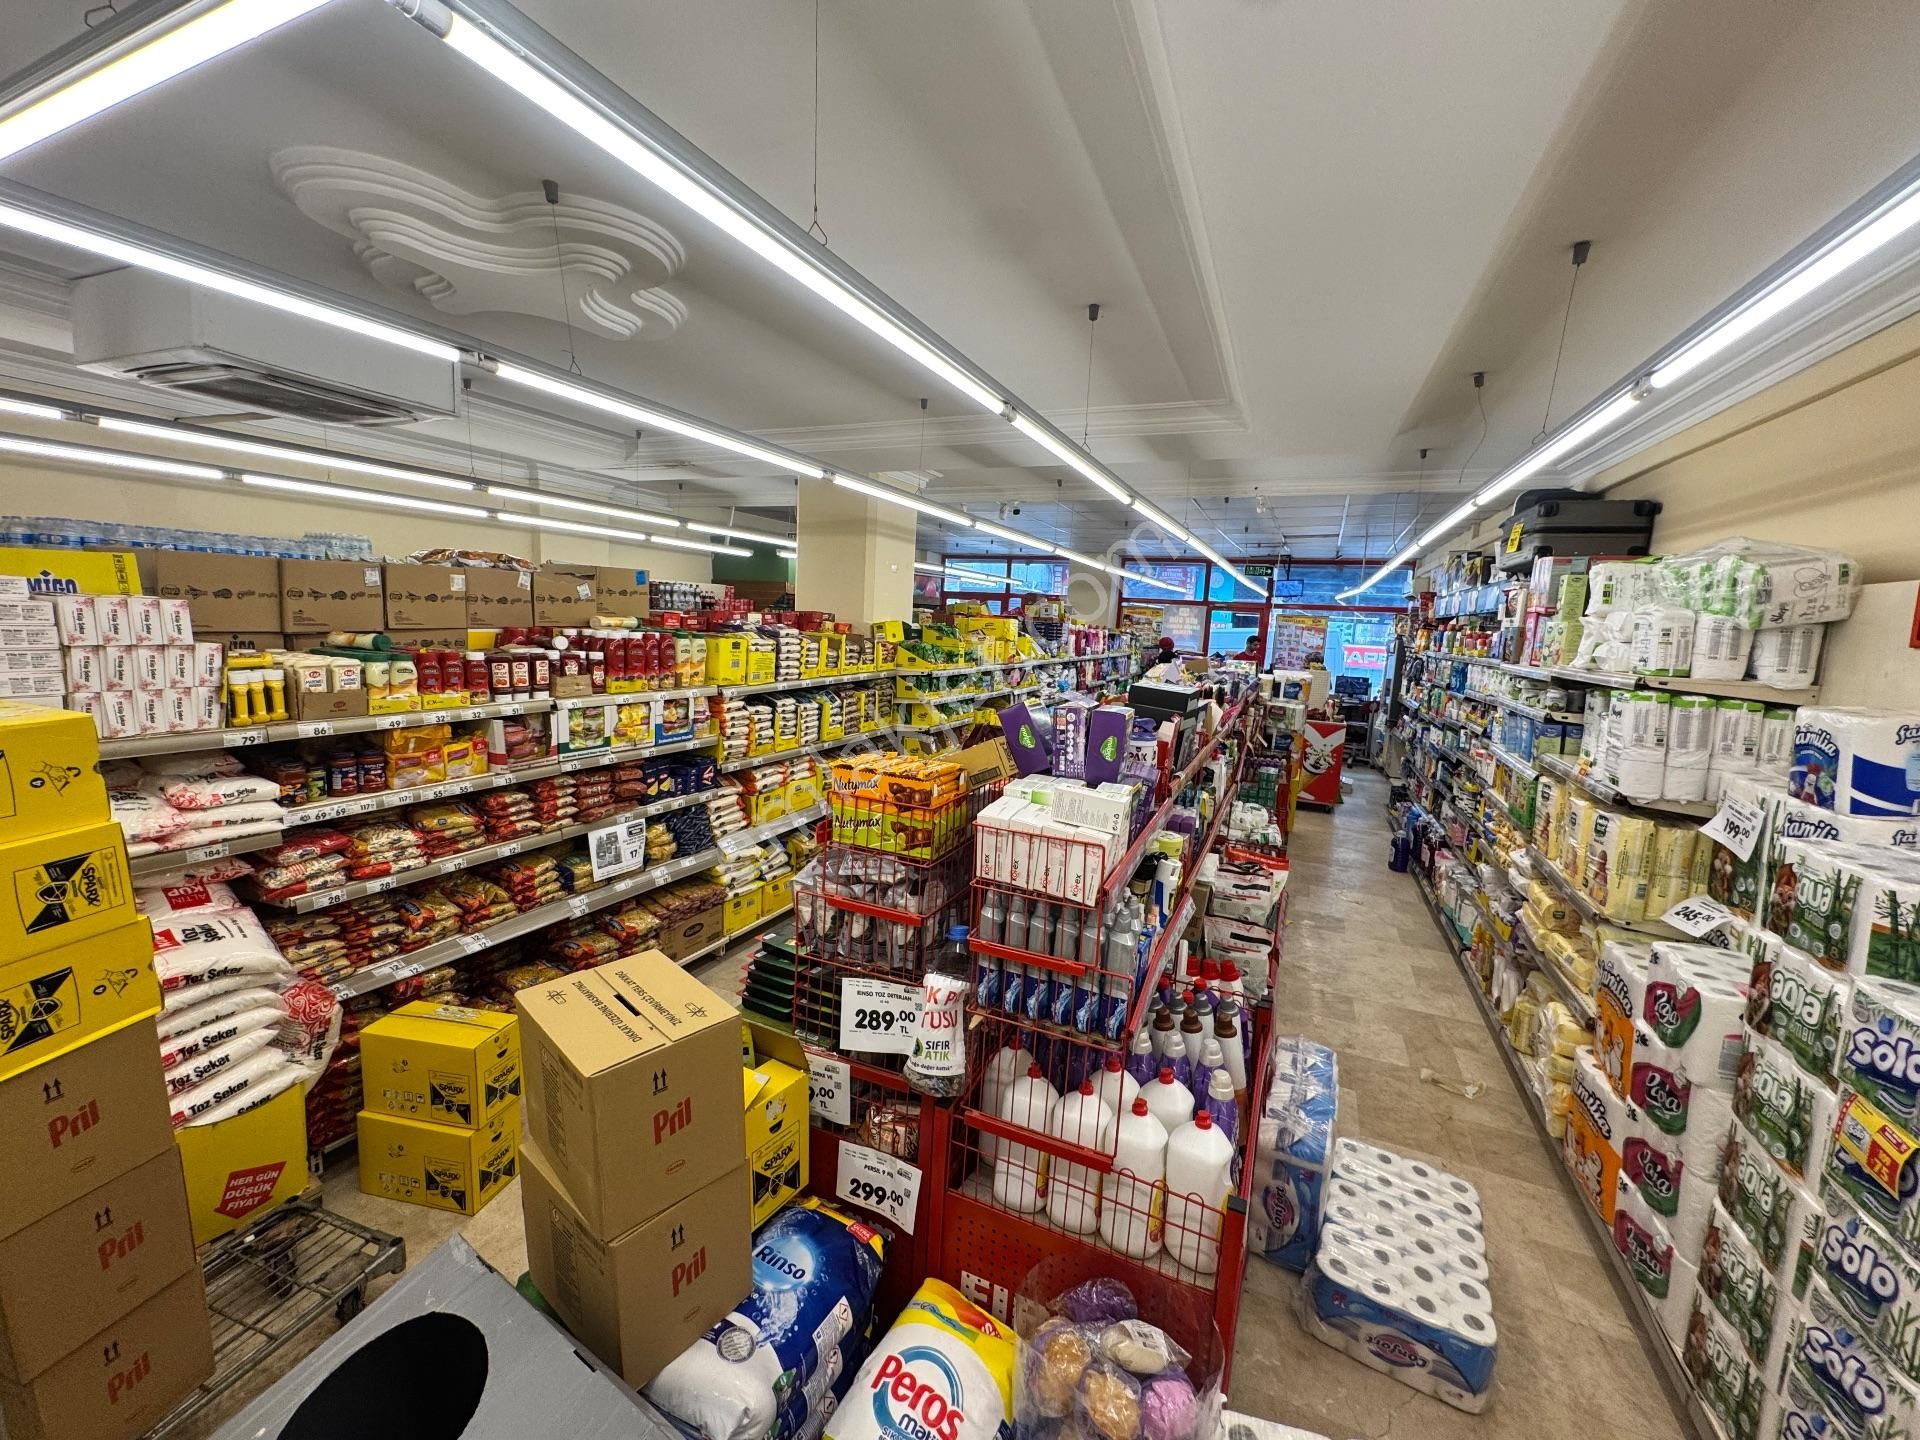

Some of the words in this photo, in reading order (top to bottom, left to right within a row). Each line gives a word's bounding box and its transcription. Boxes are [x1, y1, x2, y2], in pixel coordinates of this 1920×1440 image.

[435, 715, 446, 723] 32
[472, 711, 482, 719] 32
[313, 728, 327, 736] 86
[389, 720, 401, 728] 49
[241, 736, 255, 745] 79
[833, 777, 879, 793] Nutymax
[315, 812, 327, 820] 69
[335, 808, 346, 816] 69
[834, 814, 882, 834] Nutymax
[203, 849, 221, 858] 184
[630, 849, 638, 859] 17
[82, 864, 101, 907] SPARX
[379, 882, 391, 890] 28
[328, 894, 341, 905] 28
[900, 1025, 909, 1034] TL
[178, 1042, 200, 1058] Toz
[925, 1040, 951, 1051] SIFIR
[924, 1050, 950, 1062] ATIK
[493, 1063, 517, 1085] SPARX
[168, 1073, 193, 1092] Toz
[439, 1082, 466, 1096] SPARX
[188, 1099, 212, 1116] Toz
[820, 1100, 828, 1109] TL
[47, 1099, 101, 1150] Pril
[652, 1096, 693, 1146] Pril
[487, 1144, 510, 1169] SPARX
[763, 1142, 794, 1171] SPARX
[229, 1175, 254, 1188] HER
[255, 1170, 280, 1182] GÜN
[433, 1169, 461, 1181] SPARX
[224, 1182, 274, 1200] DÜŞÜK
[226, 1196, 262, 1211] FİYAT
[889, 1204, 897, 1217] TL
[98, 1221, 146, 1272] Pril
[756, 1245, 807, 1281] Rinso
[1825, 1224, 1900, 1304] Solo
[671, 1246, 707, 1298] Pril
[107, 1351, 151, 1406] Pril
[1804, 1326, 1885, 1415] Solo
[871, 1354, 965, 1440] Peros
